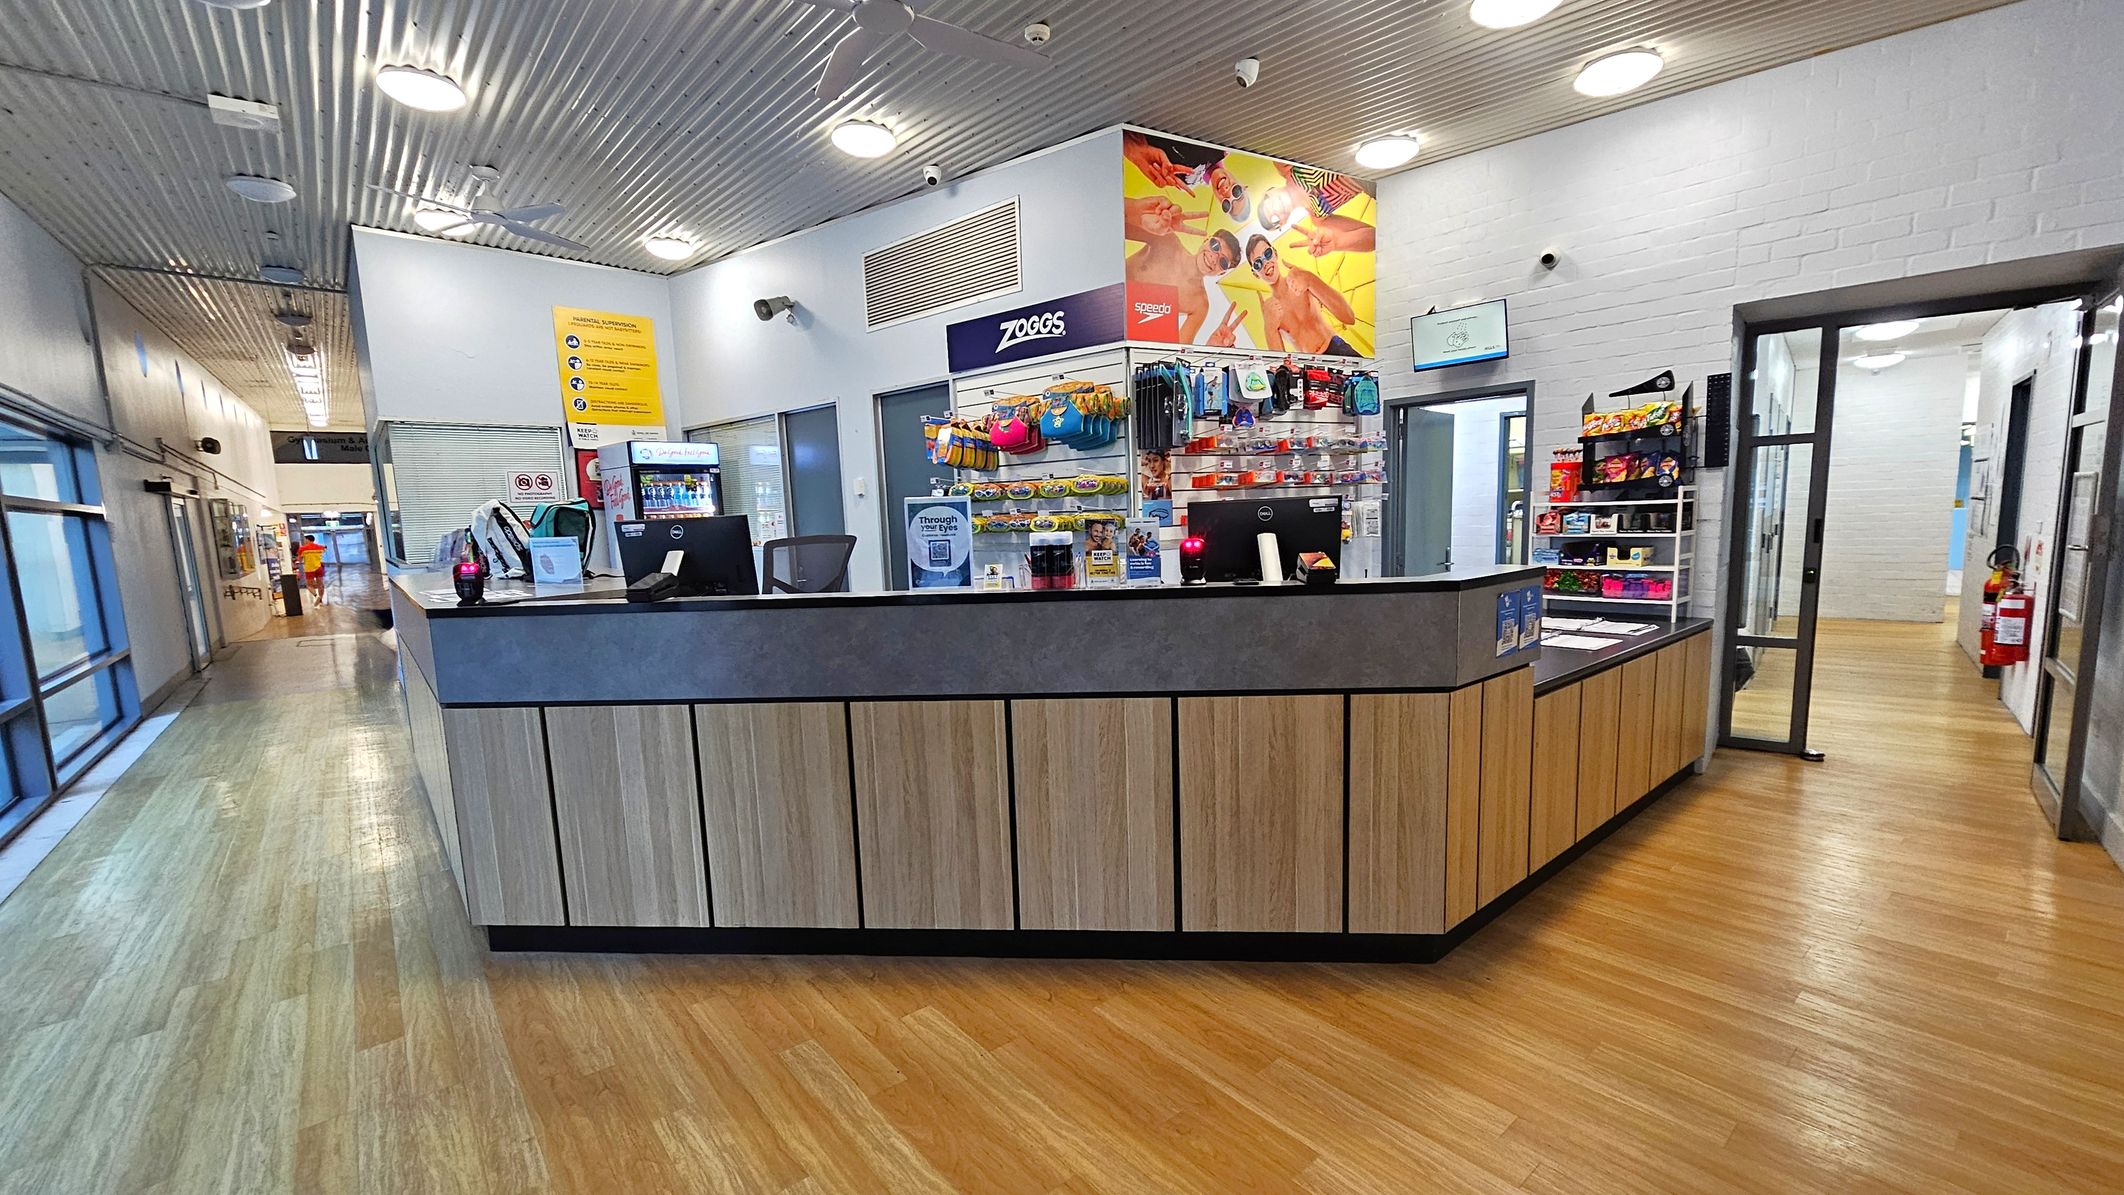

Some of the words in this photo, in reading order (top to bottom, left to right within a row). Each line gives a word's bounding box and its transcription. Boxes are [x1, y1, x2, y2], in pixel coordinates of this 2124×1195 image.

[1134, 302, 1172, 315] speedo
[573, 316, 600, 325] PARENTAL
[601, 319, 637, 329] SUPERVISION
[995, 310, 1066, 353] ZOGGS
[919, 515, 958, 525] Through
[920, 524, 937, 532] your
[939, 524, 958, 533] Eyes
